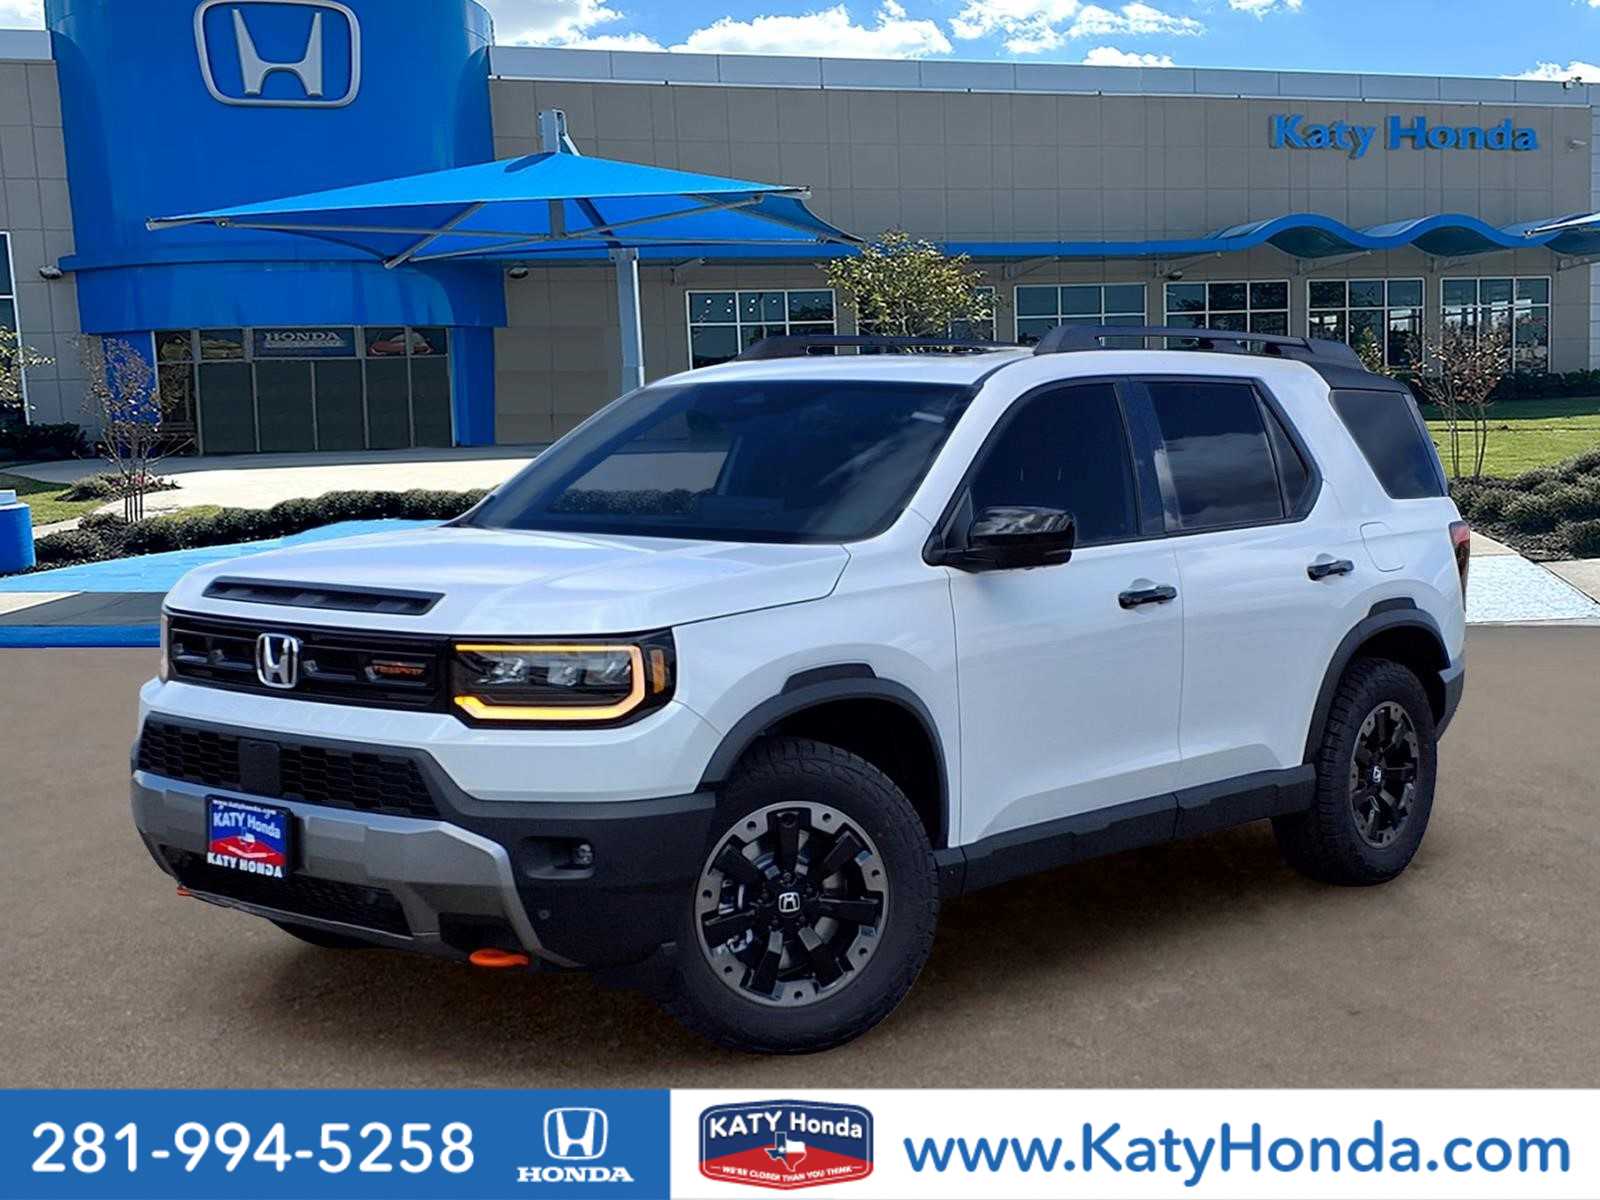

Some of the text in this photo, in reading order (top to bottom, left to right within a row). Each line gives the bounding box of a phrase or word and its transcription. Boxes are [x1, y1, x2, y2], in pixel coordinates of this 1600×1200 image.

[1271, 114, 1538, 159] Katy Honda
[265, 331, 341, 341] HONDA
[213, 812, 281, 838] KATY Honda
[207, 852, 237, 868] KATY
